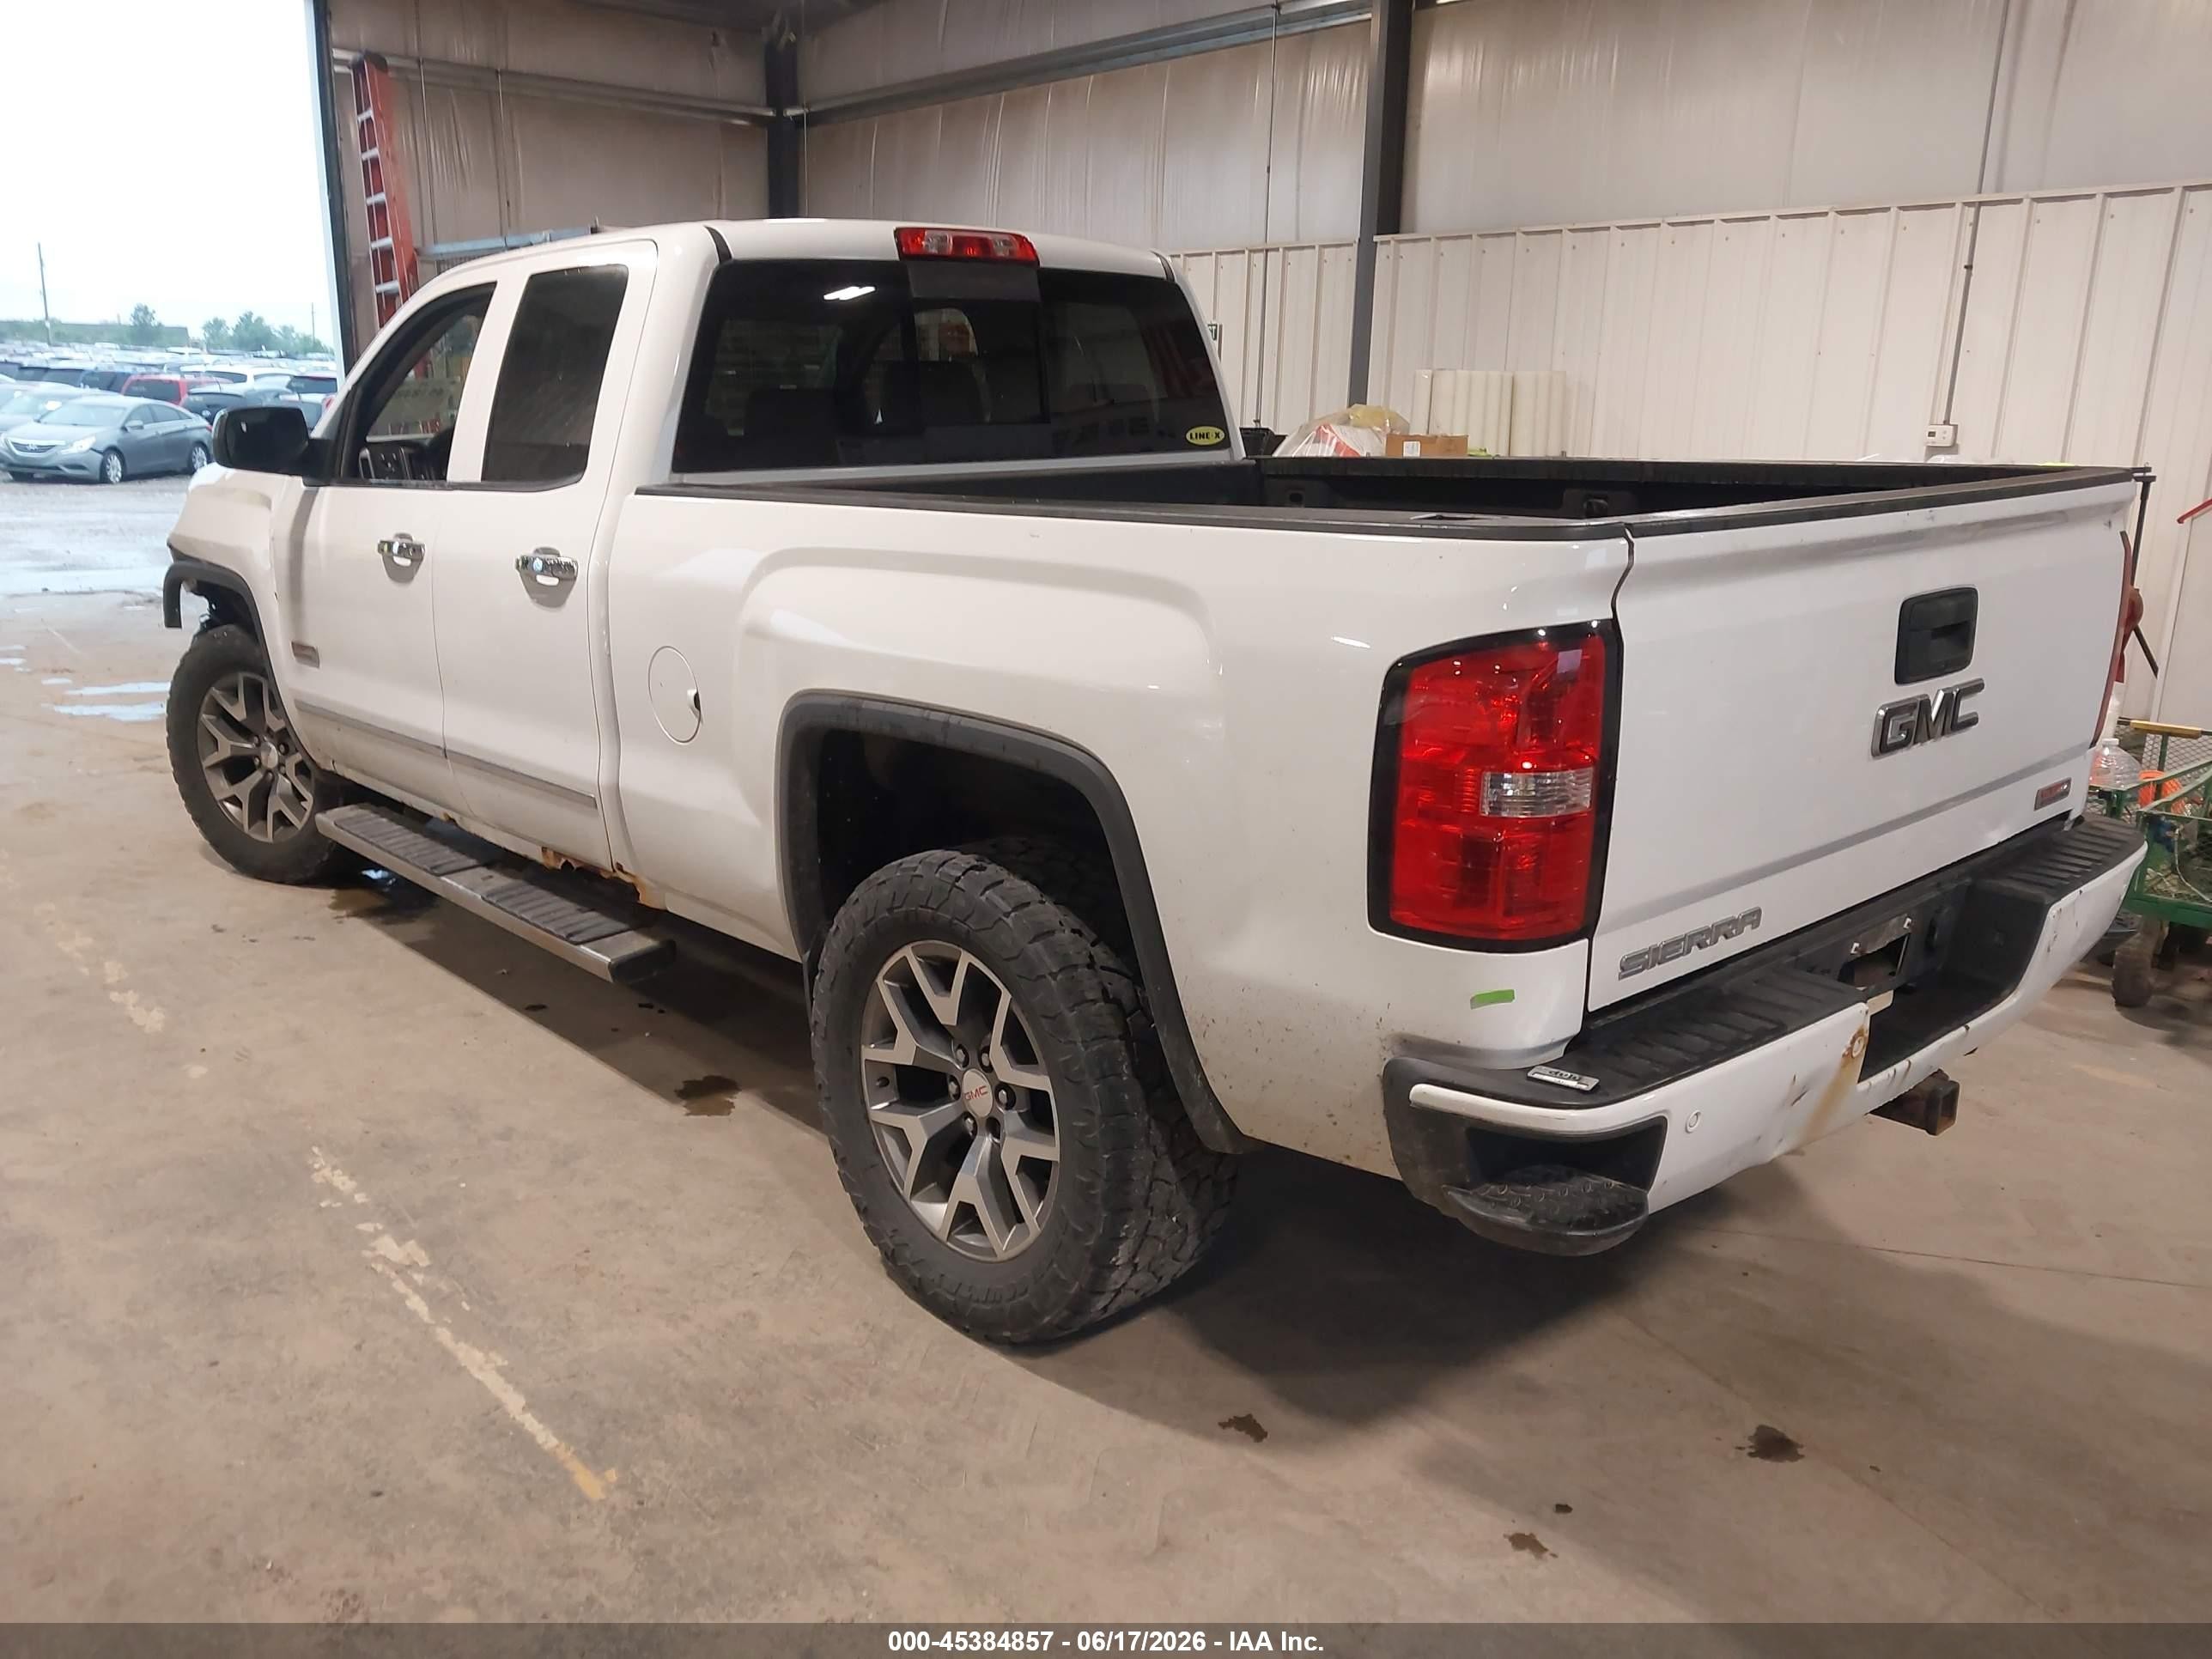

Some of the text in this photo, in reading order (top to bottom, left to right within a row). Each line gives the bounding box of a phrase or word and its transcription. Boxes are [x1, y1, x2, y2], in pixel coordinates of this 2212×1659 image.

[1871, 678, 1985, 759] GMC
[1618, 906, 1762, 981] SIERRA
[963, 1085, 988, 1100] GMC
